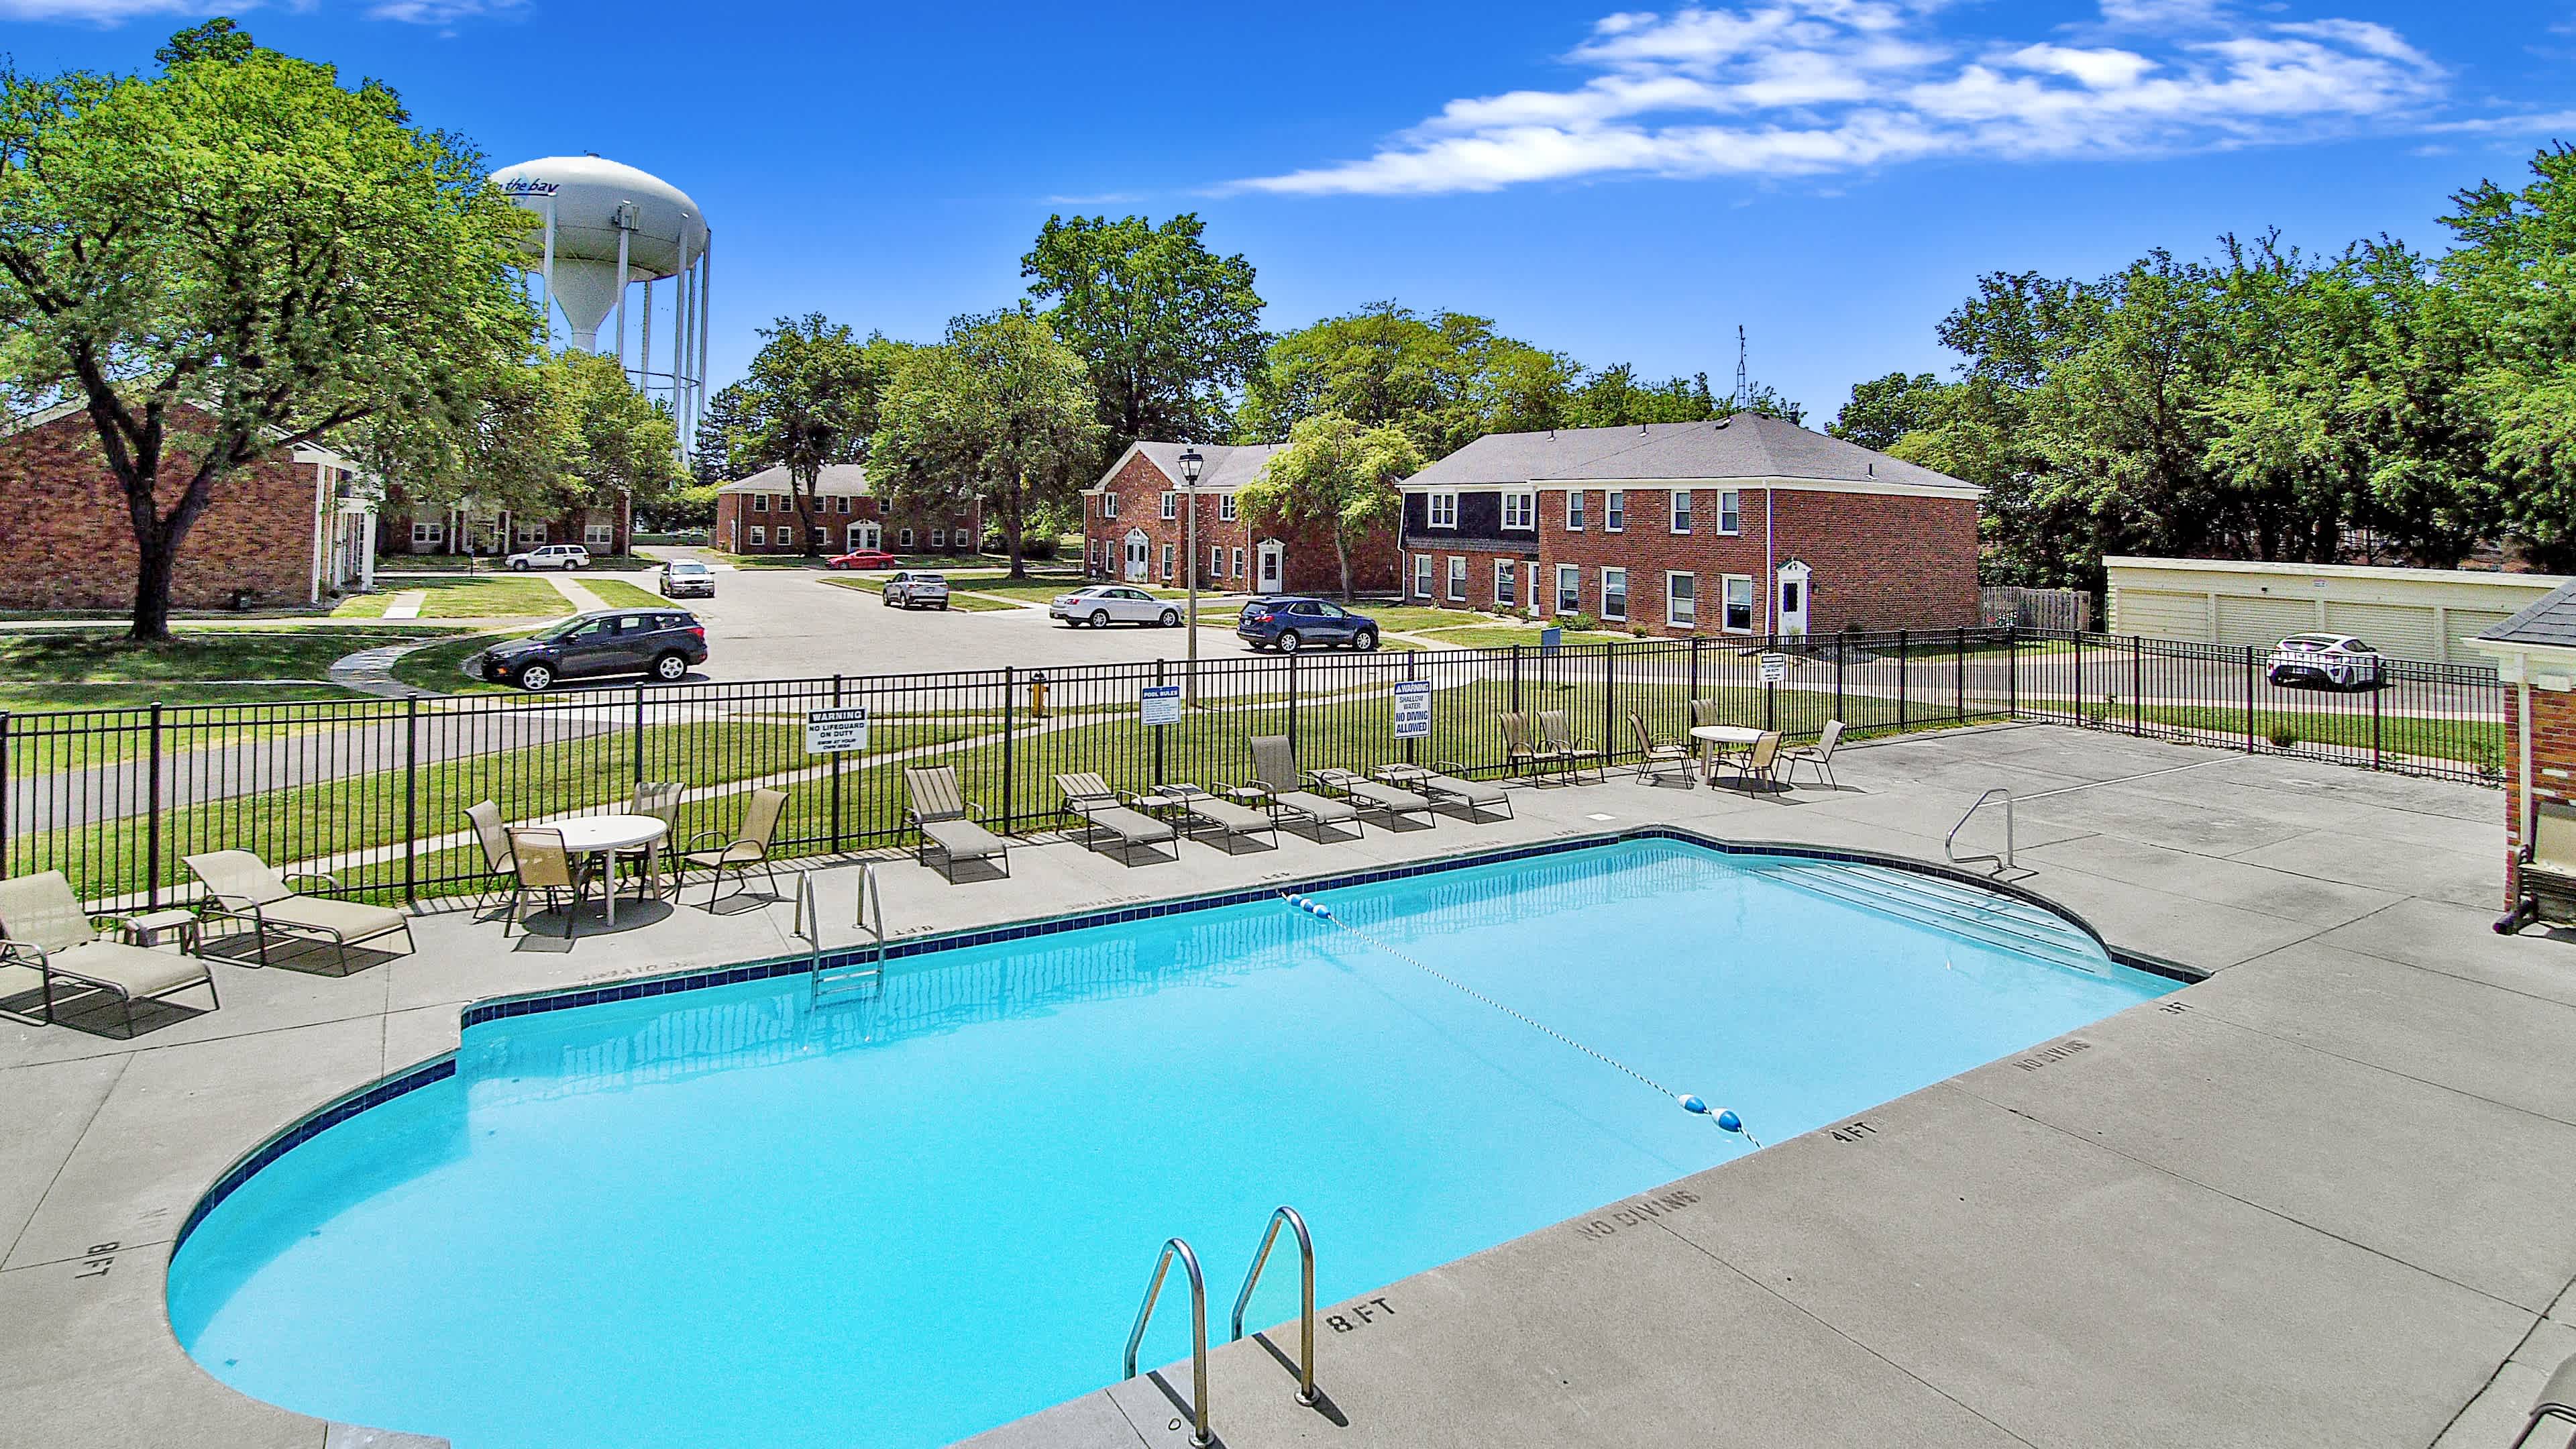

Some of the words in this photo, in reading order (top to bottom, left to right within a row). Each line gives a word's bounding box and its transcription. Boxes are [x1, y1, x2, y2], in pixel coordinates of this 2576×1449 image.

[505, 178, 527, 191] the
[812, 710, 862, 722] WARNING
[1395, 712, 1405, 722] NO
[1407, 710, 1428, 721] DIVING
[822, 722, 865, 731] LIFEGUARD
[1396, 722, 1427, 734] ALLOWED
[1576, 1220, 1617, 1240] NO
